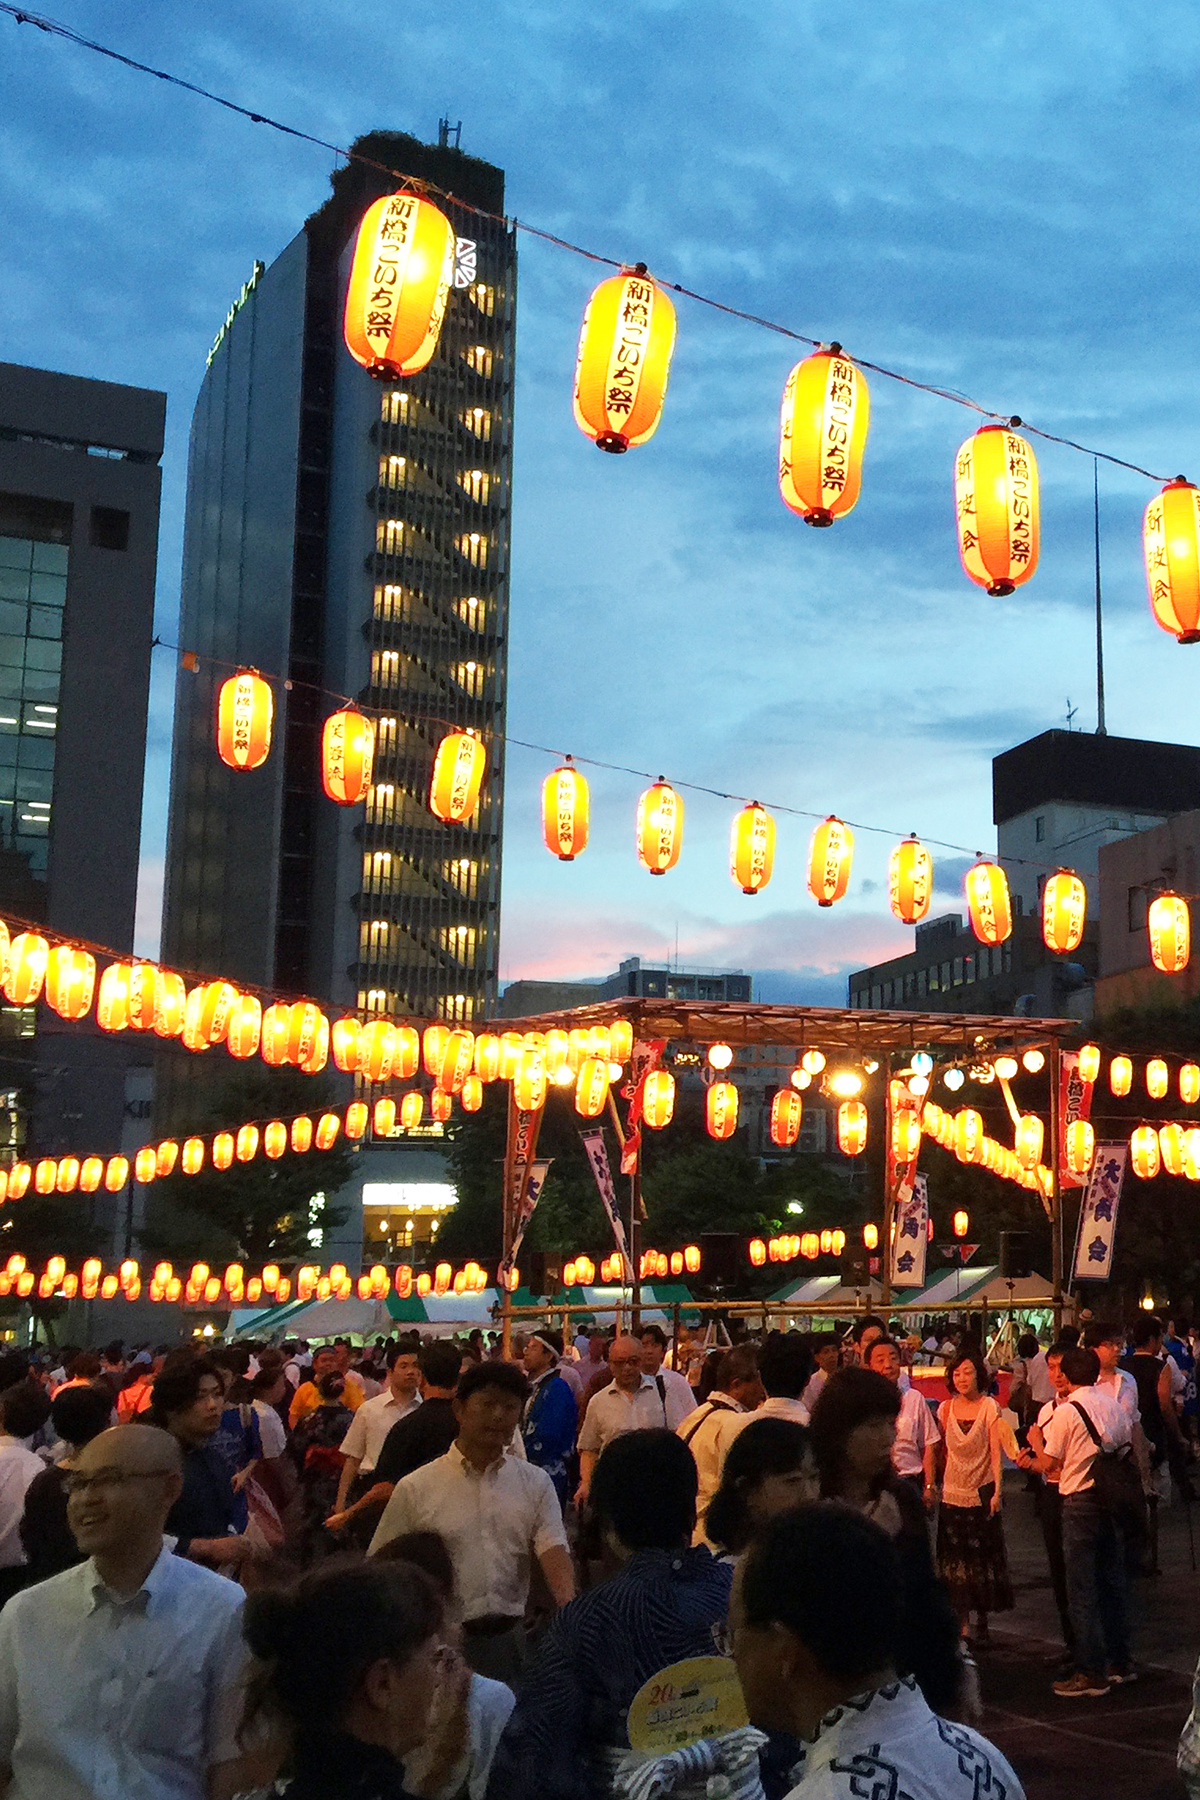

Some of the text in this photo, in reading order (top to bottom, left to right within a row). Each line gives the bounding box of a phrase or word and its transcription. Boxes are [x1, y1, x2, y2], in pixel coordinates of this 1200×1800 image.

[366, 197, 414, 339] 新橋こいち祭
[605, 279, 652, 416] 新橋こいち祭
[822, 360, 853, 492] 新橋こいち祭
[1006, 435, 1030, 564] 新橋こいち祭
[233, 684, 250, 751] 新橋こいち祭
